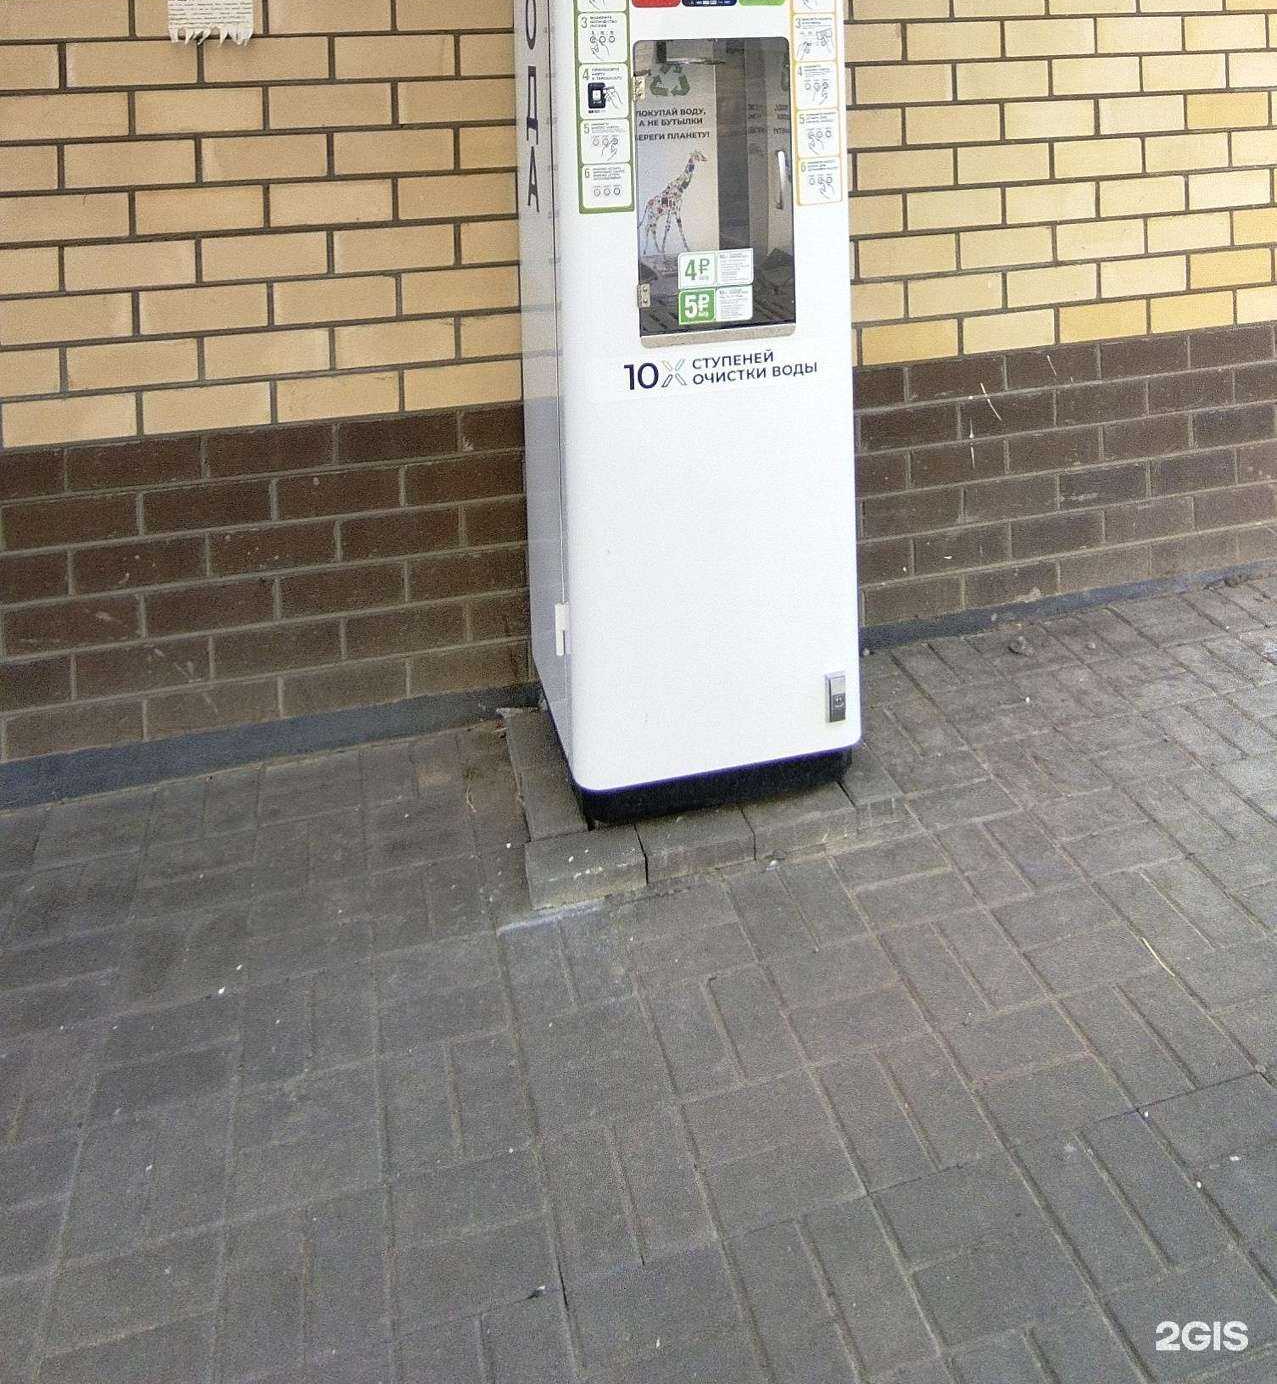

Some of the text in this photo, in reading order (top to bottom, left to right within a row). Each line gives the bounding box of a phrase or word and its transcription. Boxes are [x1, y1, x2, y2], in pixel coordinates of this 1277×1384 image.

[636, 107, 706, 117] ПОКУПАЙ ВОДУ,
[661, 118, 703, 127] БУТЫЛКИ
[667, 131, 710, 140] ПЛАНЕТУ!
[692, 348, 774, 369] СТУПЕНЕЙ
[693, 362, 818, 385] ОЧИСТКИ ВОДЫ
